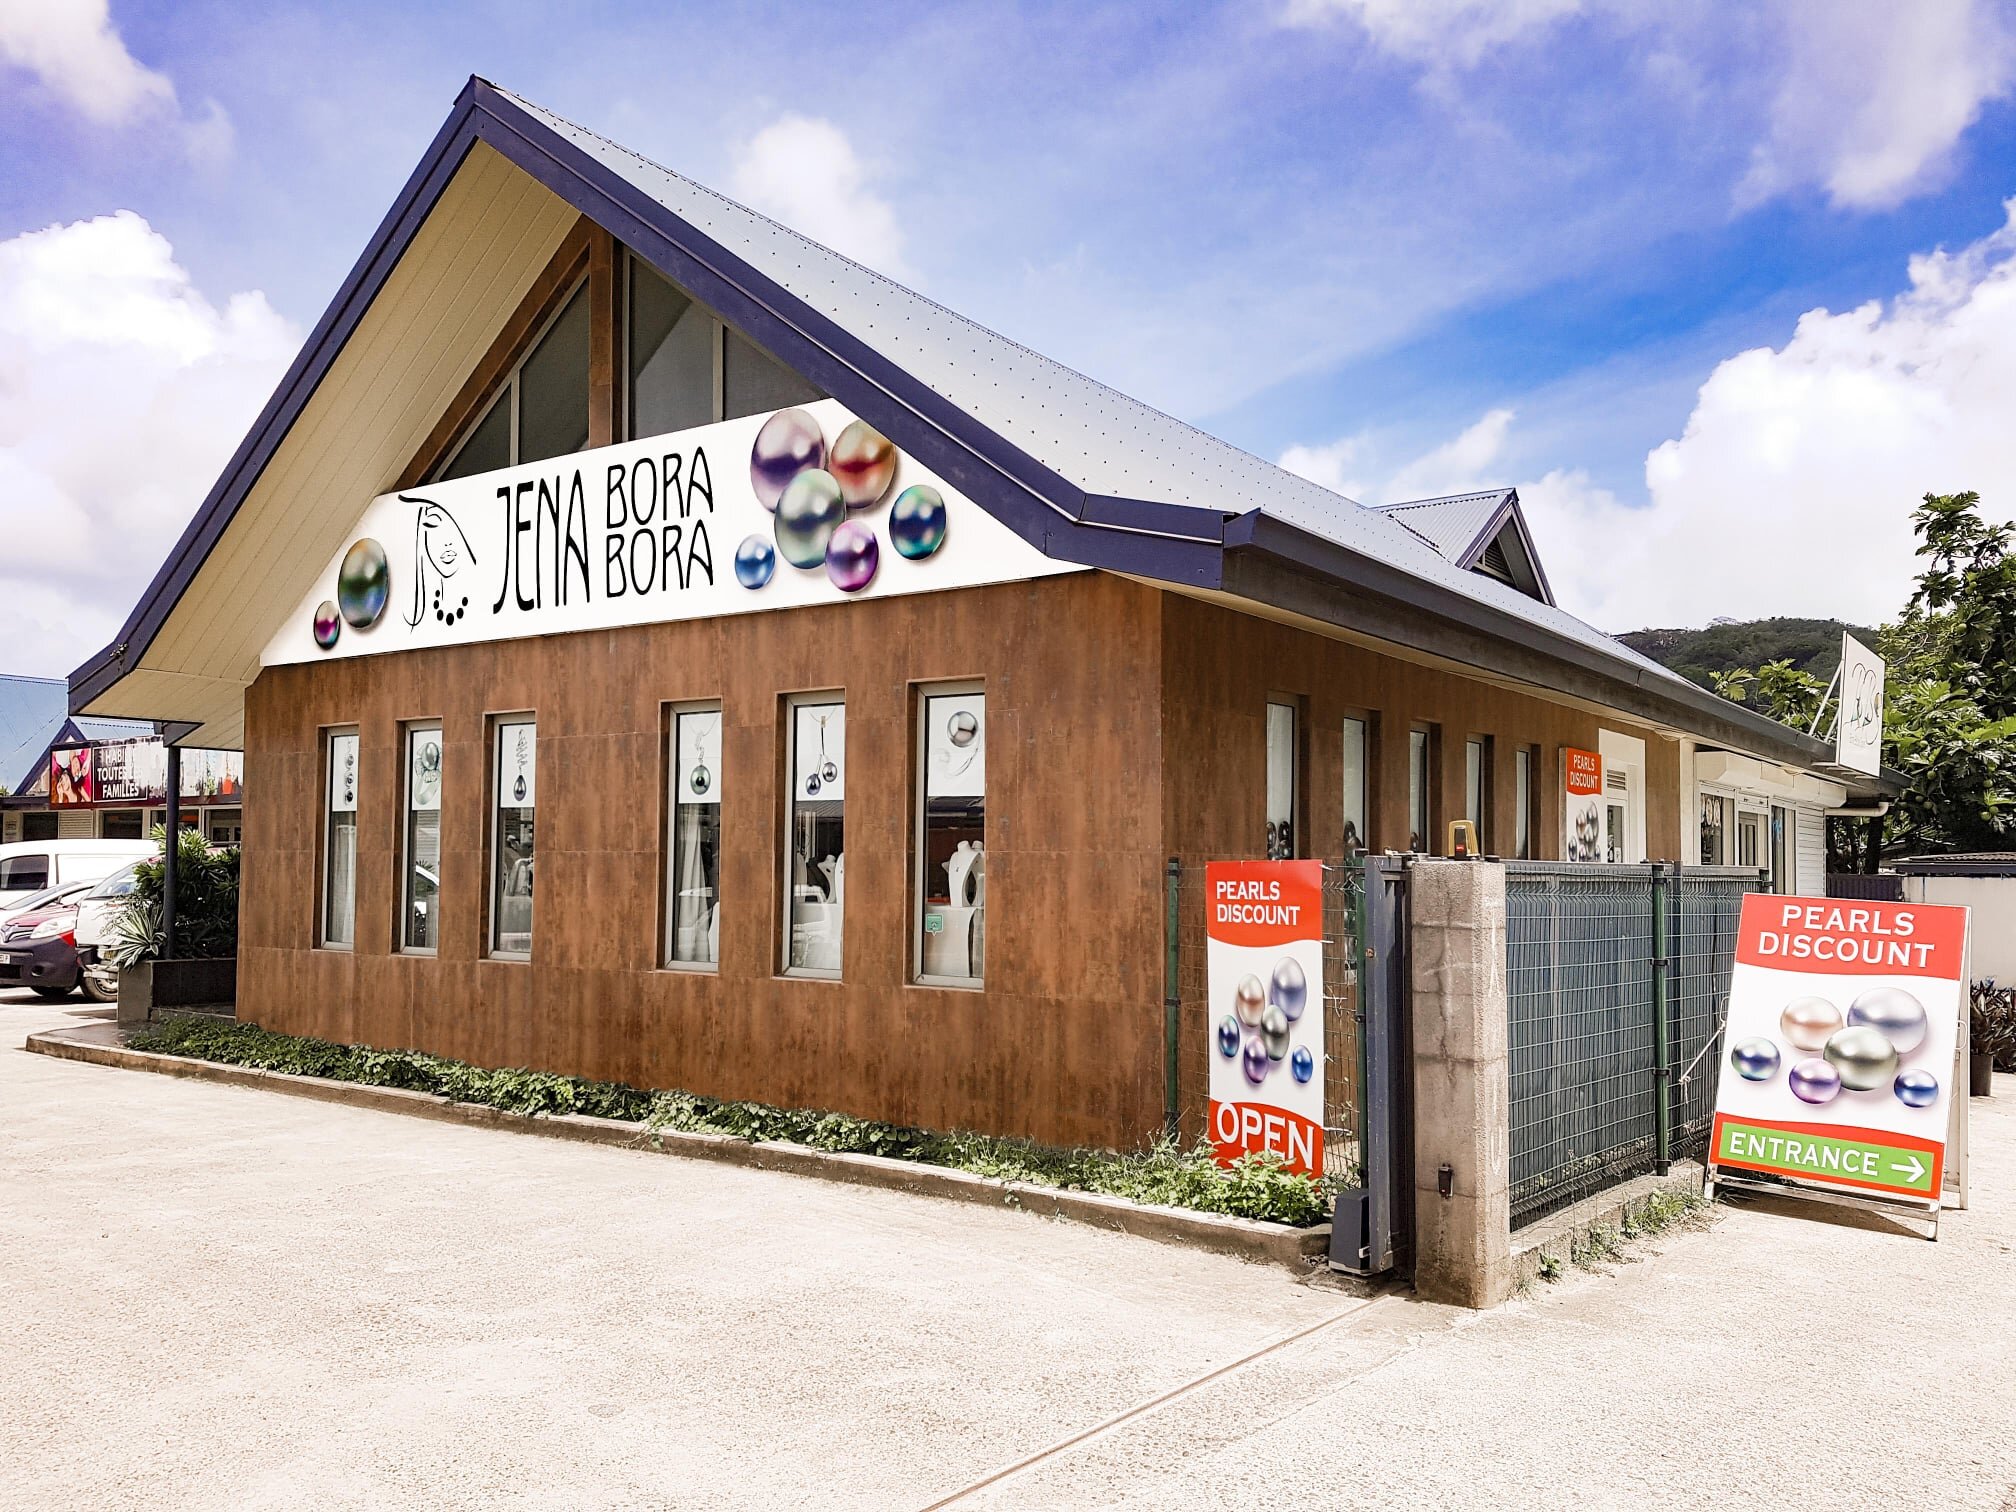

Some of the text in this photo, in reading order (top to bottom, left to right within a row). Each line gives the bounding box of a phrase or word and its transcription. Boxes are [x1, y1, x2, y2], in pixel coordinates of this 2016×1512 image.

[606, 446, 714, 529] BORA
[493, 469, 590, 614] JENA
[606, 519, 714, 598] BORA
[1570, 771, 1598, 789] DISCOUNT
[1573, 754, 1595, 771] PEARLS
[102, 783, 139, 798] FAMILLES
[1216, 880, 1281, 901] PEARLS
[1216, 905, 1301, 926] DISCOUNT
[1781, 904, 1914, 937] PEARLS
[1757, 931, 1936, 968] DISCOUNT
[1216, 1102, 1315, 1171] OPEN
[1729, 1132, 1880, 1177] ENTRANCE
